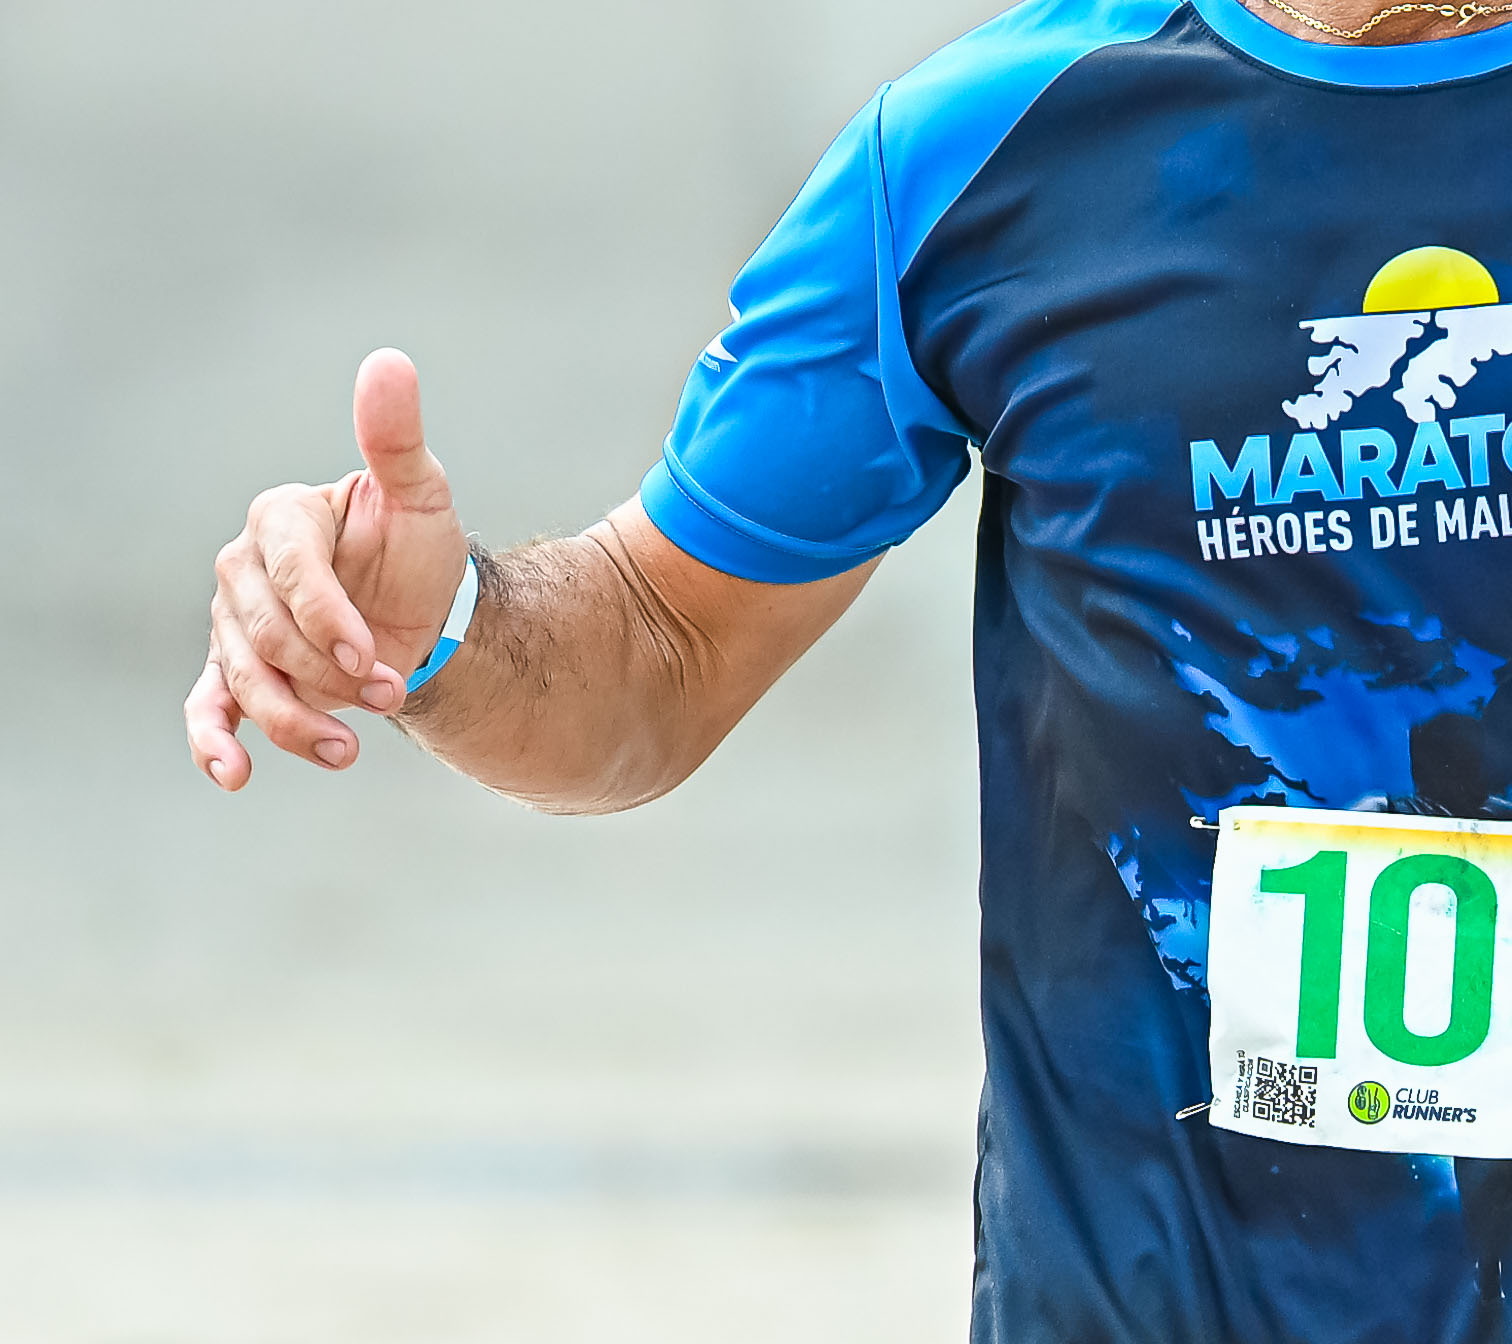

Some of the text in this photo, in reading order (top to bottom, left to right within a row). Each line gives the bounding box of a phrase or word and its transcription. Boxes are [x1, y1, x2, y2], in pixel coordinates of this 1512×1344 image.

[1196, 507, 1354, 562] HÉROES
[1369, 503, 1421, 548] DE
[1395, 1087, 1439, 1105] CLUB
[1392, 1104, 1477, 1124] RUNNER'S
